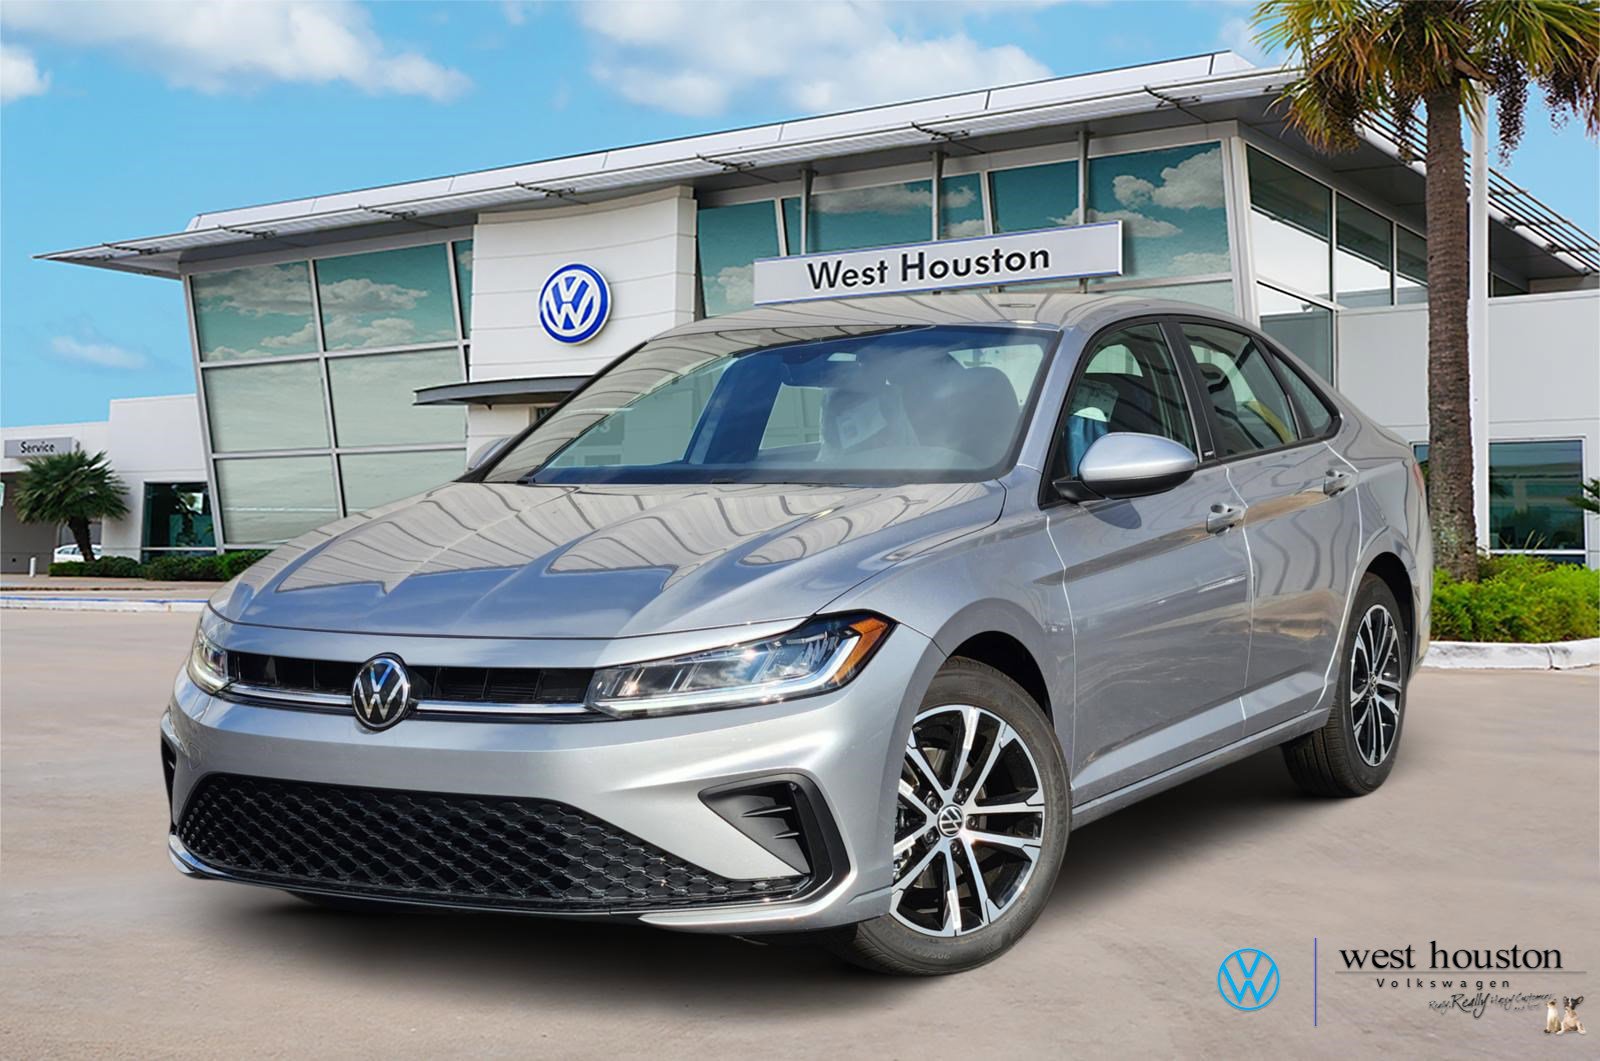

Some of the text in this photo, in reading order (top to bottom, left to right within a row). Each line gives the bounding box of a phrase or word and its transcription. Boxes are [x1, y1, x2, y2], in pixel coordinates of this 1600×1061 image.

[807, 248, 1050, 290] West Houston
[541, 267, 603, 338] VW
[20, 440, 55, 454] Service
[354, 658, 407, 724] VW
